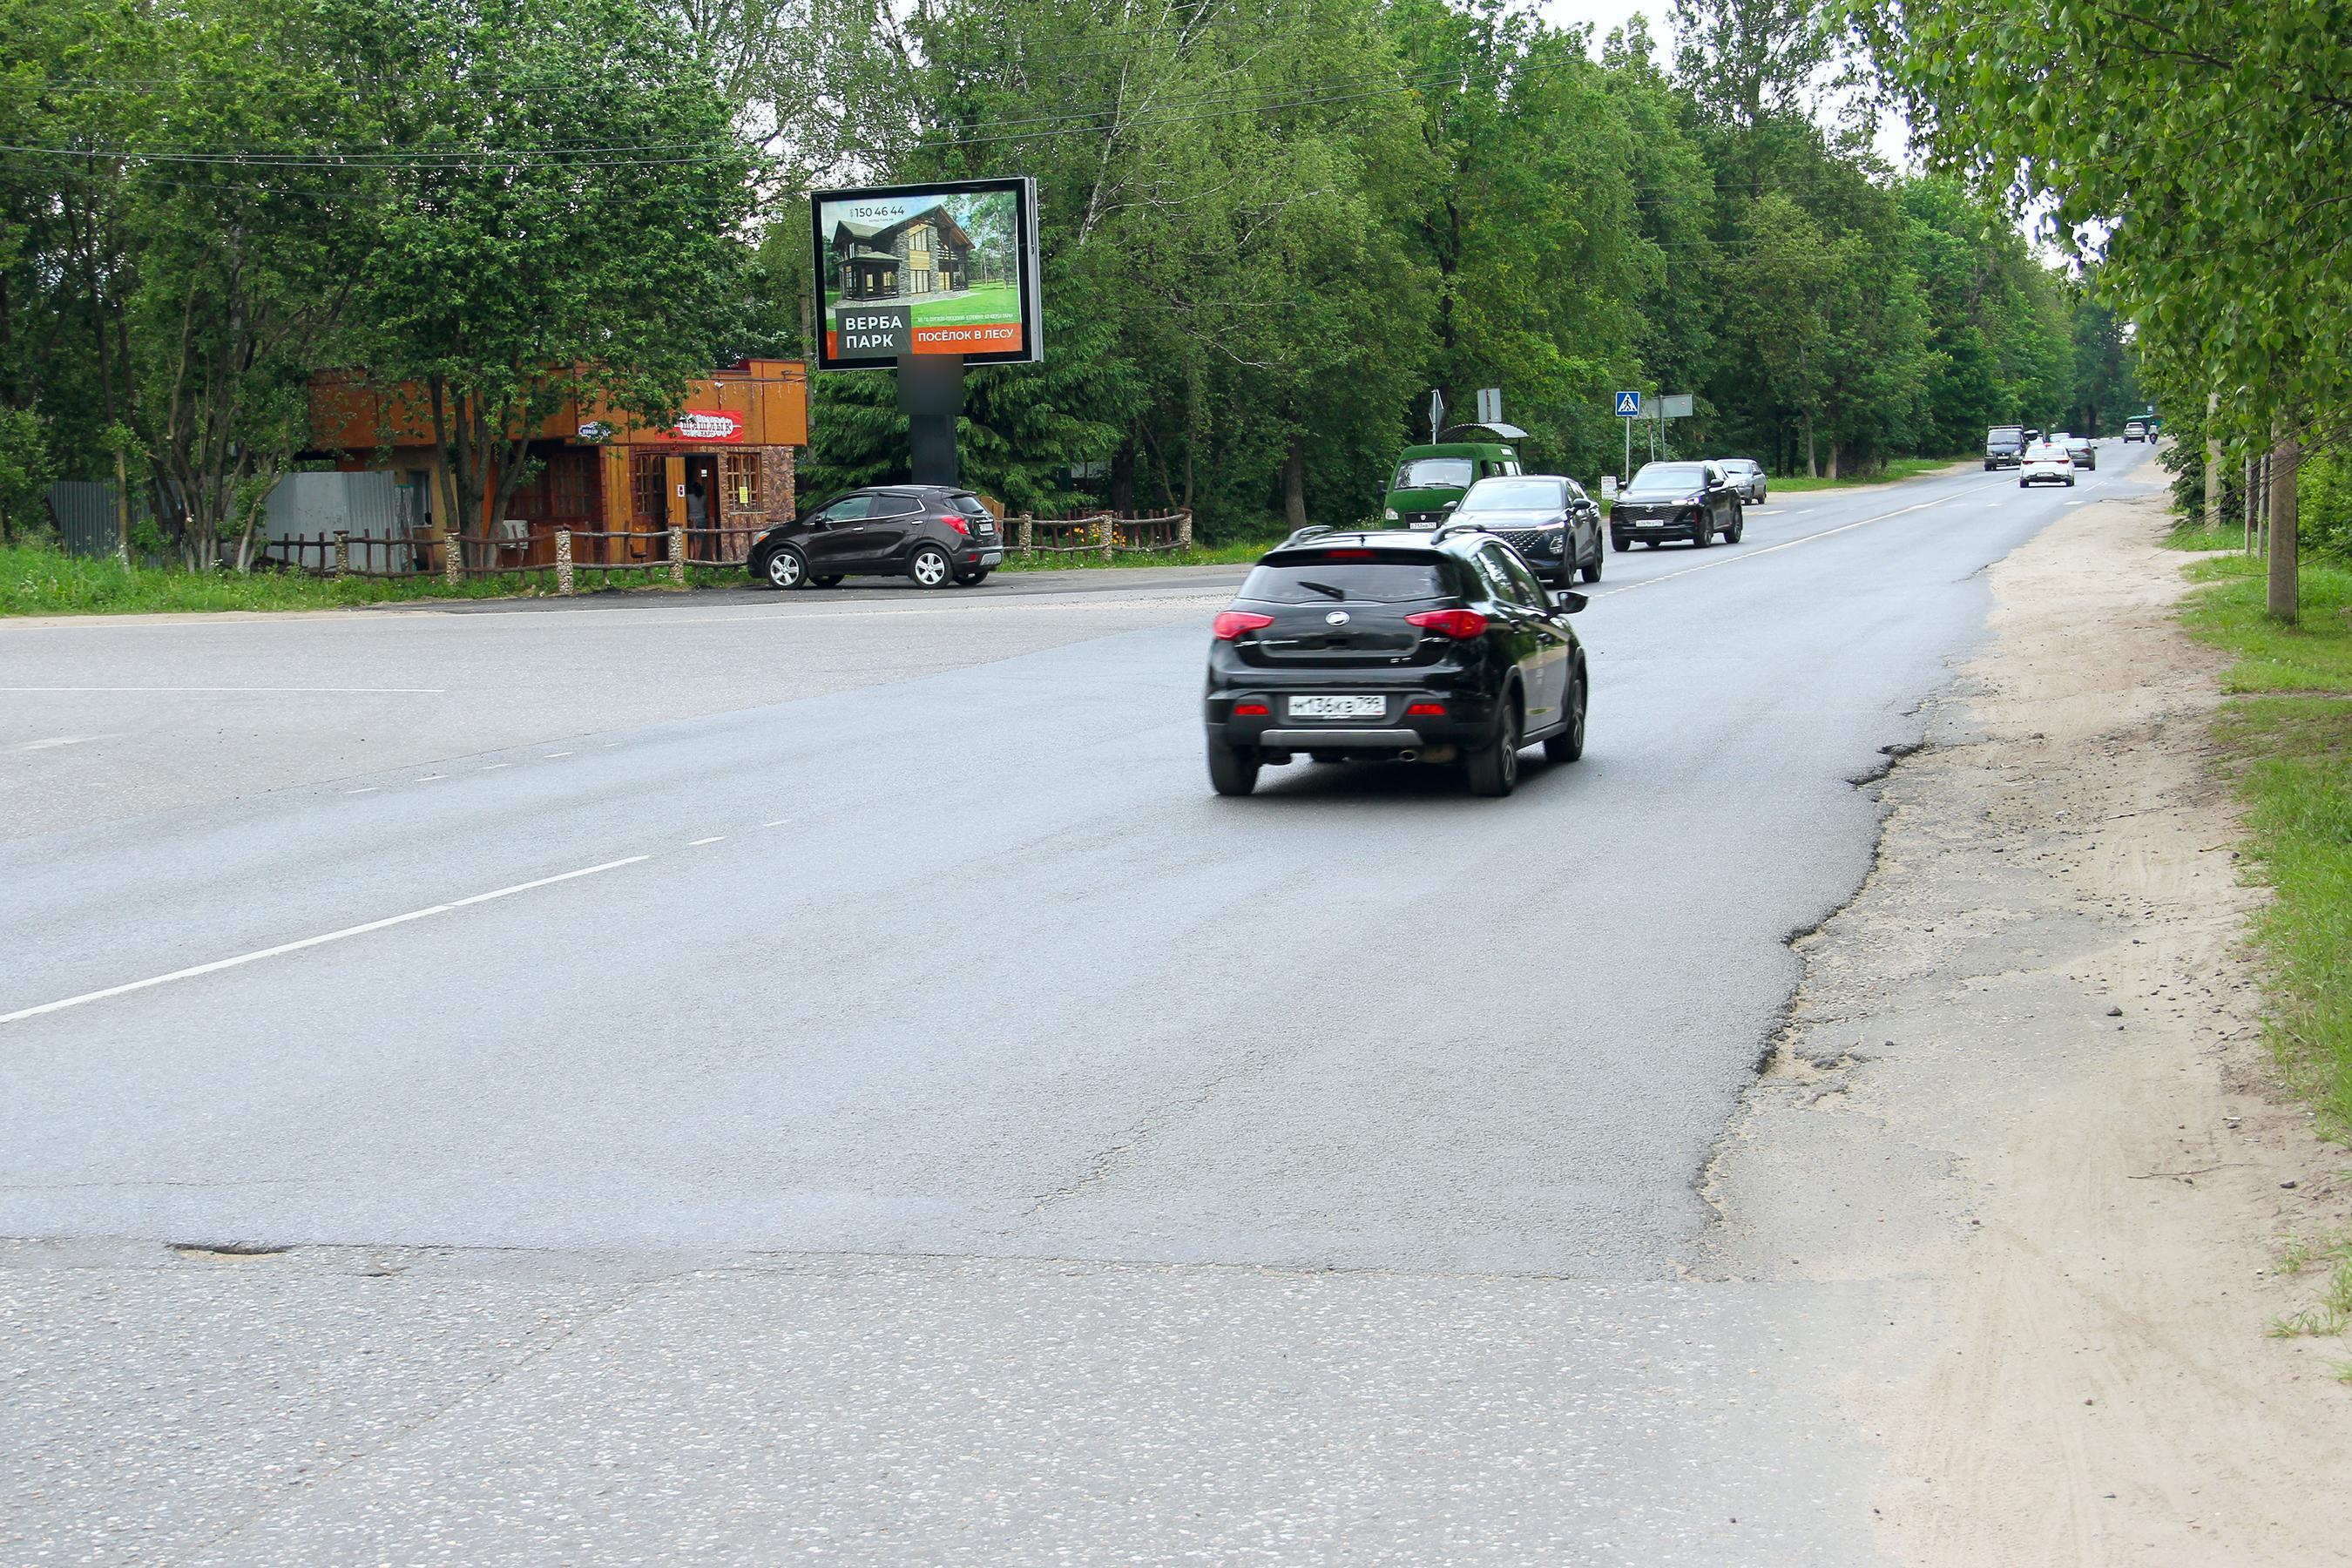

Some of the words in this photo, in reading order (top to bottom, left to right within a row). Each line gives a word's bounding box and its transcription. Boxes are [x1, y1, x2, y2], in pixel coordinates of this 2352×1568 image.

[855, 207, 873, 218] 150
[874, 206, 889, 216] 46
[890, 206, 905, 215] 44
[845, 315, 903, 330] ВЕРБА
[846, 334, 894, 348] ПАРК
[918, 329, 971, 342] ПОСЁЛОК
[974, 331, 982, 340] В
[983, 328, 1014, 339] ЛЕСУ
[681, 422, 732, 432] ШАШЛЫК
